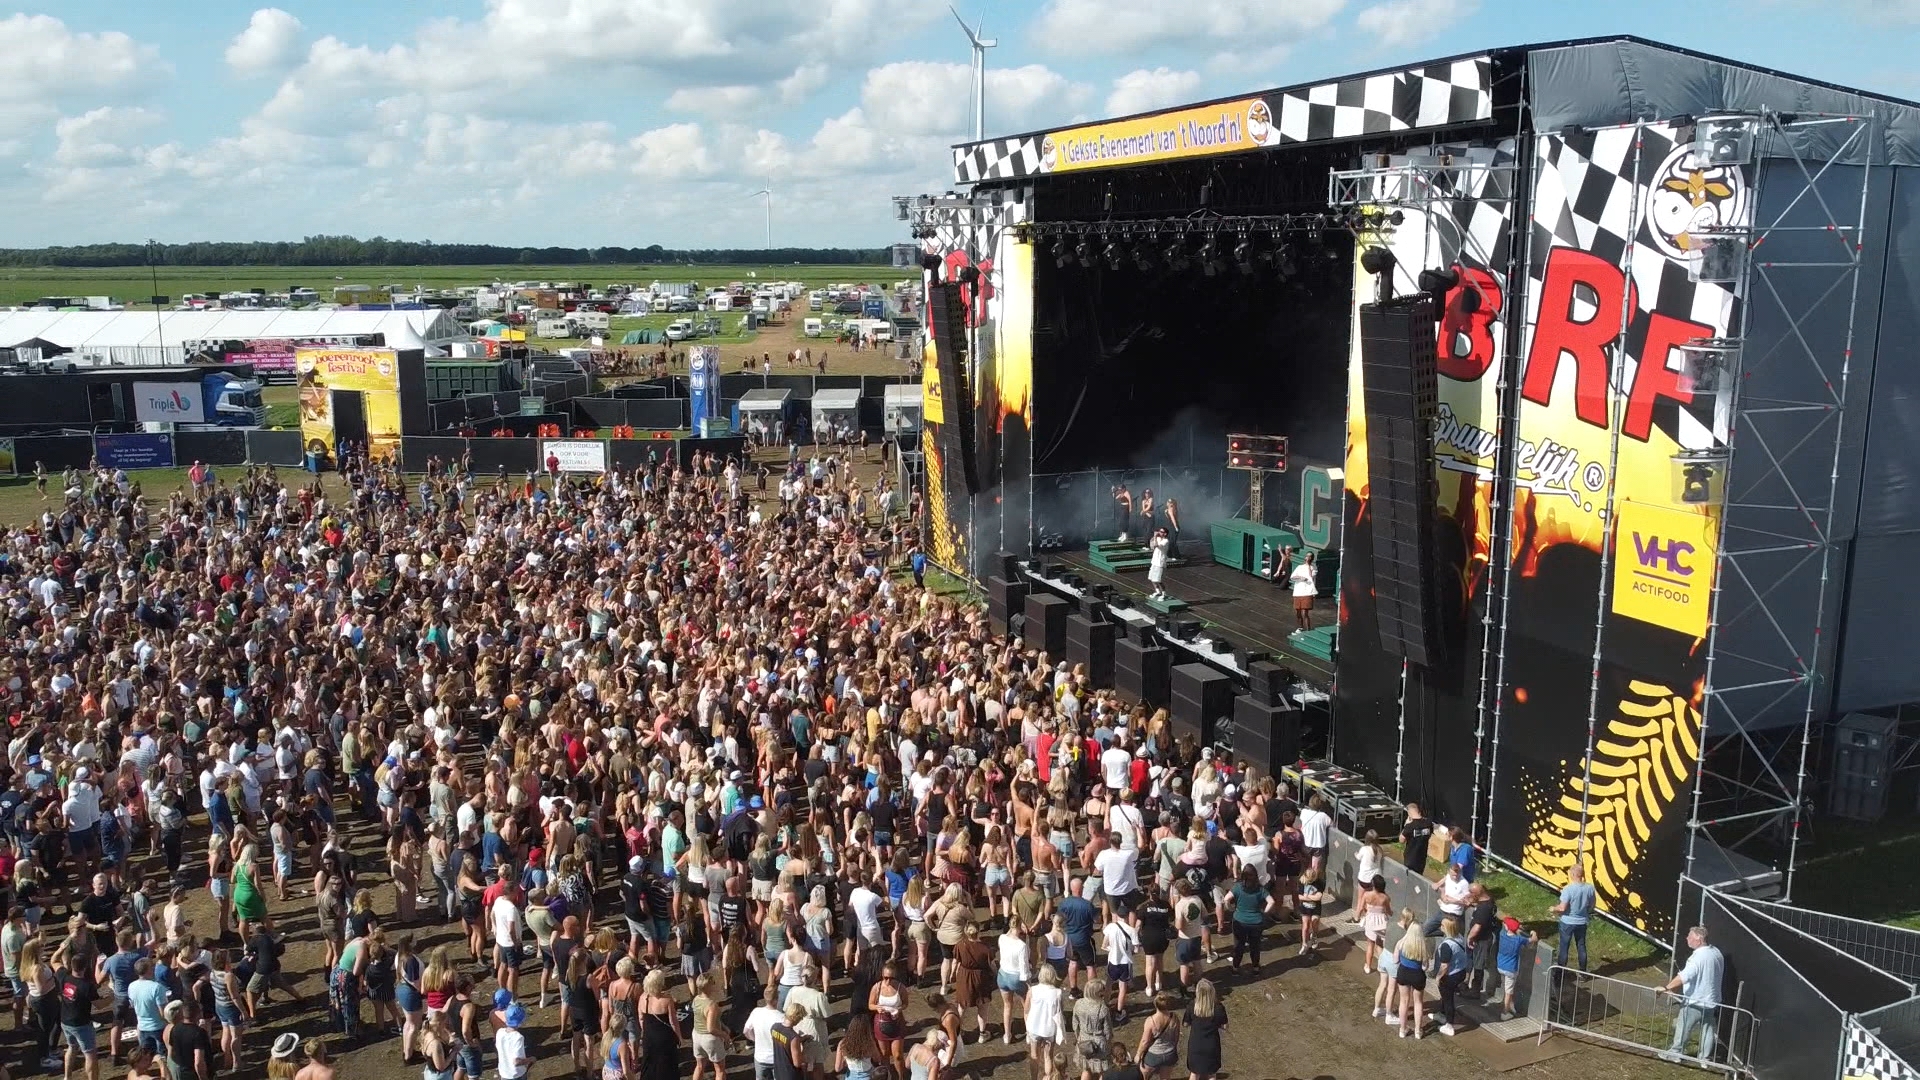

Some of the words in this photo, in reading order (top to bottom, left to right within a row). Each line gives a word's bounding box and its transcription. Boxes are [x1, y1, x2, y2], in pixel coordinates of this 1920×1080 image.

[1068, 137, 1098, 162] Gekste
[1100, 130, 1155, 159] Evenement
[1158, 130, 1176, 151] van
[1178, 121, 1187, 148] 't
[1188, 112, 1242, 146] Noord'n!
[314, 353, 376, 366] boerenrock
[328, 362, 366, 374] festival
[149, 397, 175, 412] Triple
[1632, 531, 1695, 576] VHC
[1632, 581, 1690, 604] ACTIFOOD
